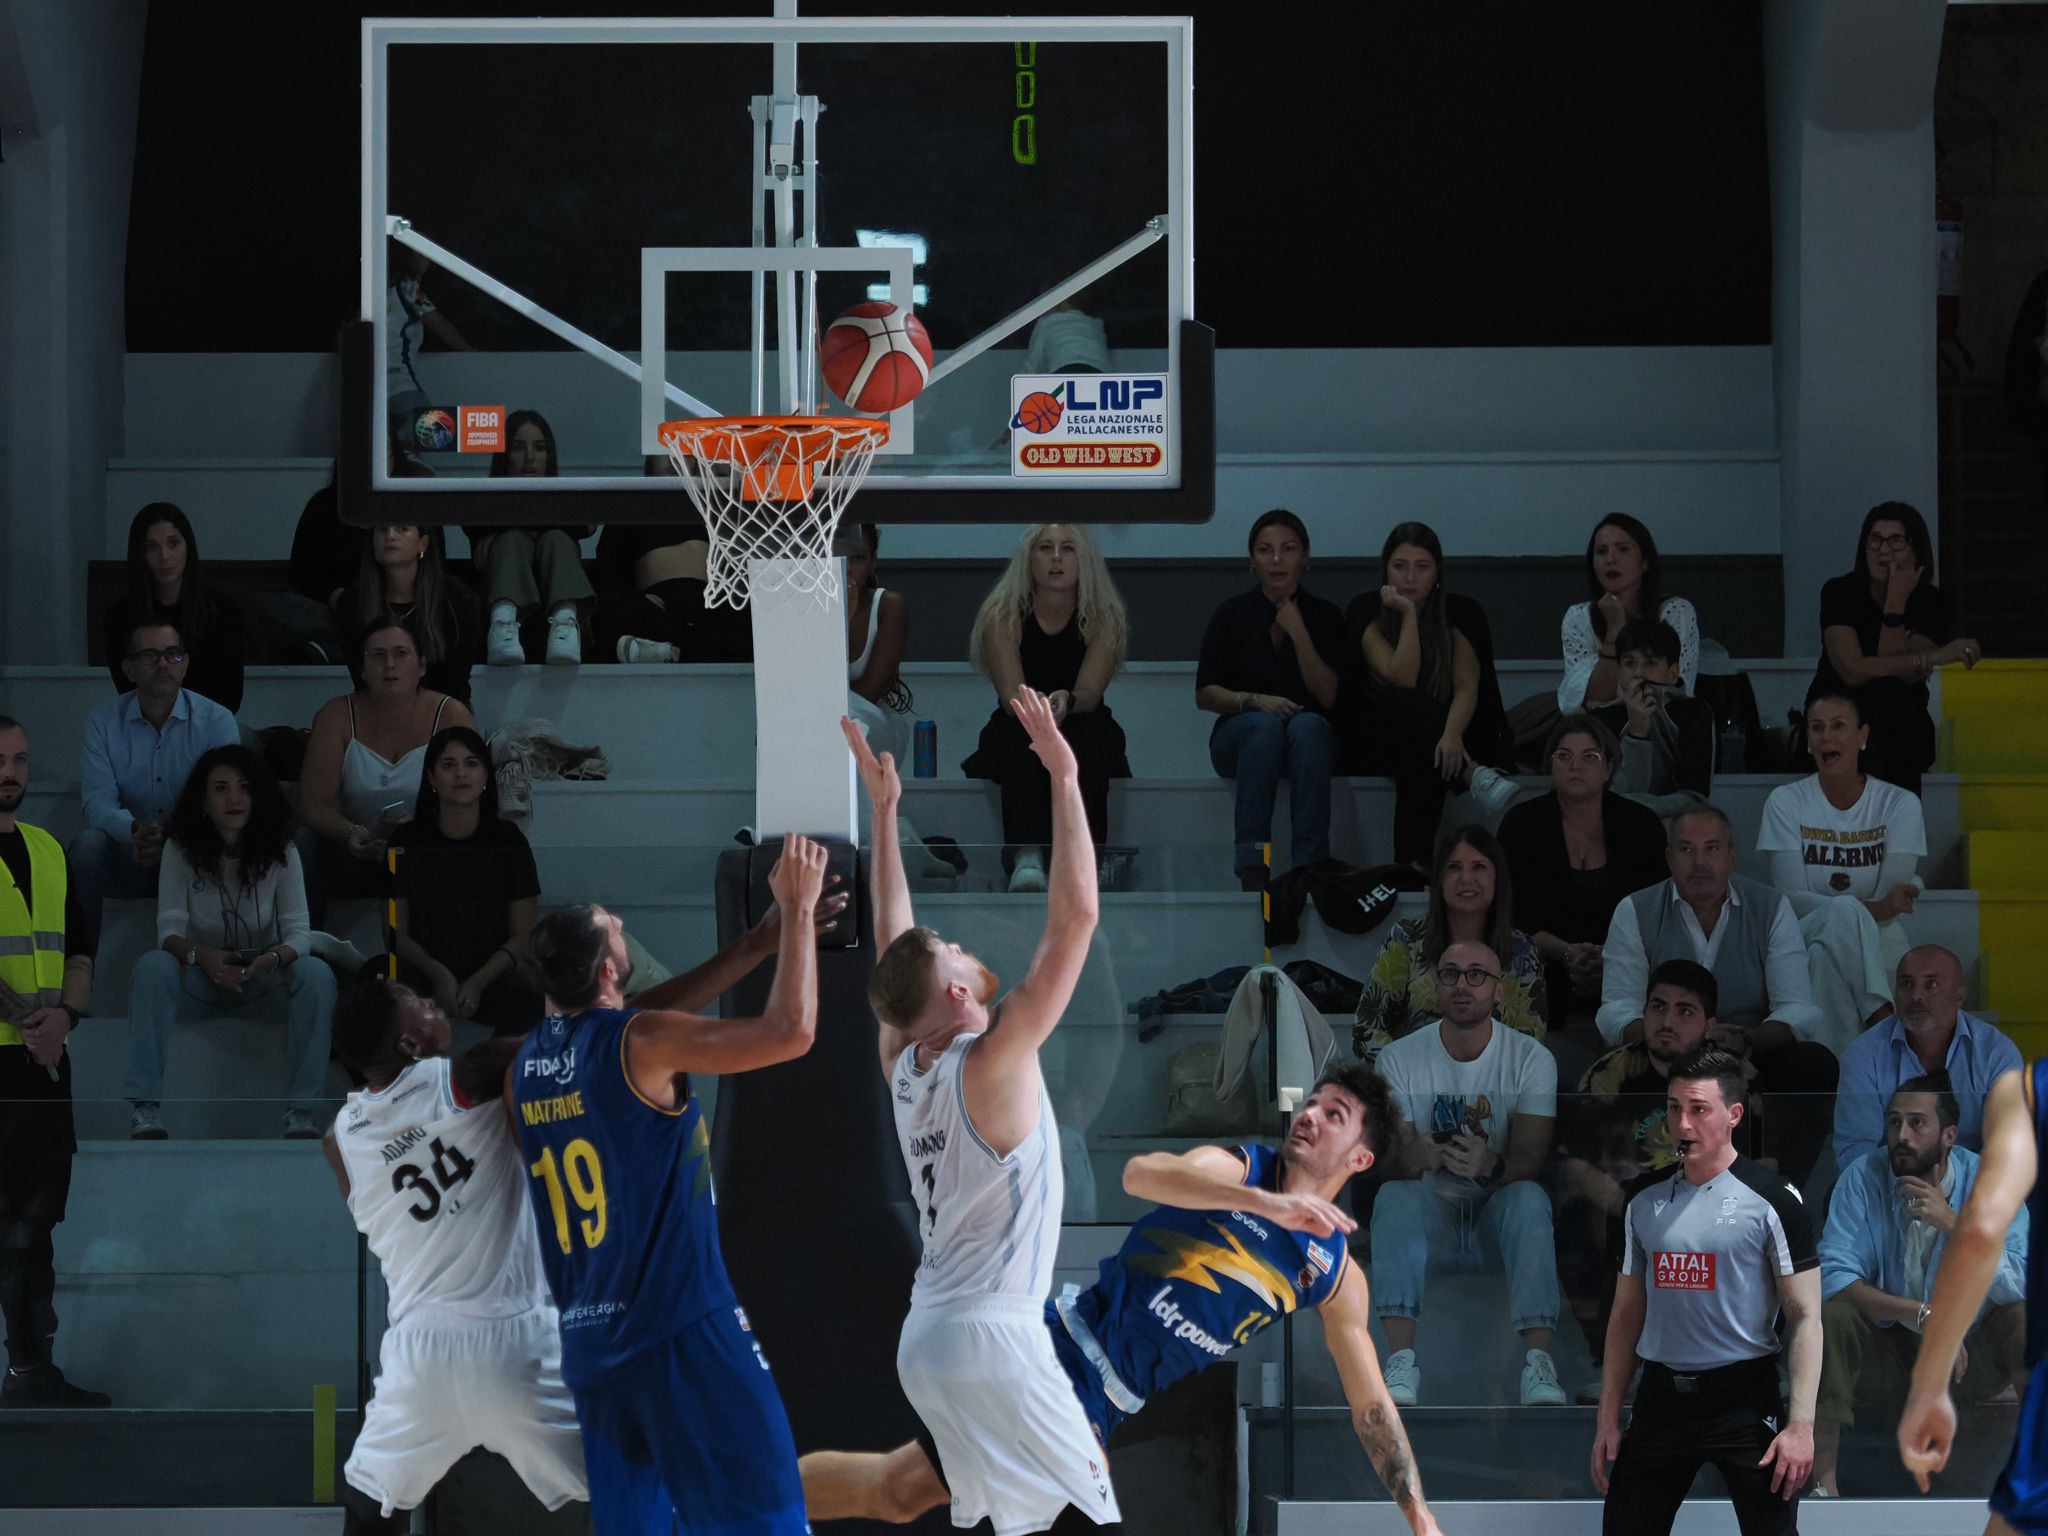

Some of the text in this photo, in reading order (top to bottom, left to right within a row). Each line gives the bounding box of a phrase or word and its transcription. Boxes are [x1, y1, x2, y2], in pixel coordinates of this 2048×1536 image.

[1066, 380, 1163, 411] LNP
[467, 412, 498, 428] FIBA
[1067, 414, 1163, 425] LEGA NAZIONALE
[1067, 425, 1164, 435] PALLACANESTRO
[1026, 447, 1156, 464] OLD WILD WEST
[1801, 842, 1886, 868] ALERN
[392, 1136, 475, 1223] 34
[530, 1137, 608, 1255] 19
[1658, 1253, 1709, 1270] ATTAL
[1658, 1271, 1709, 1282] GROUP
